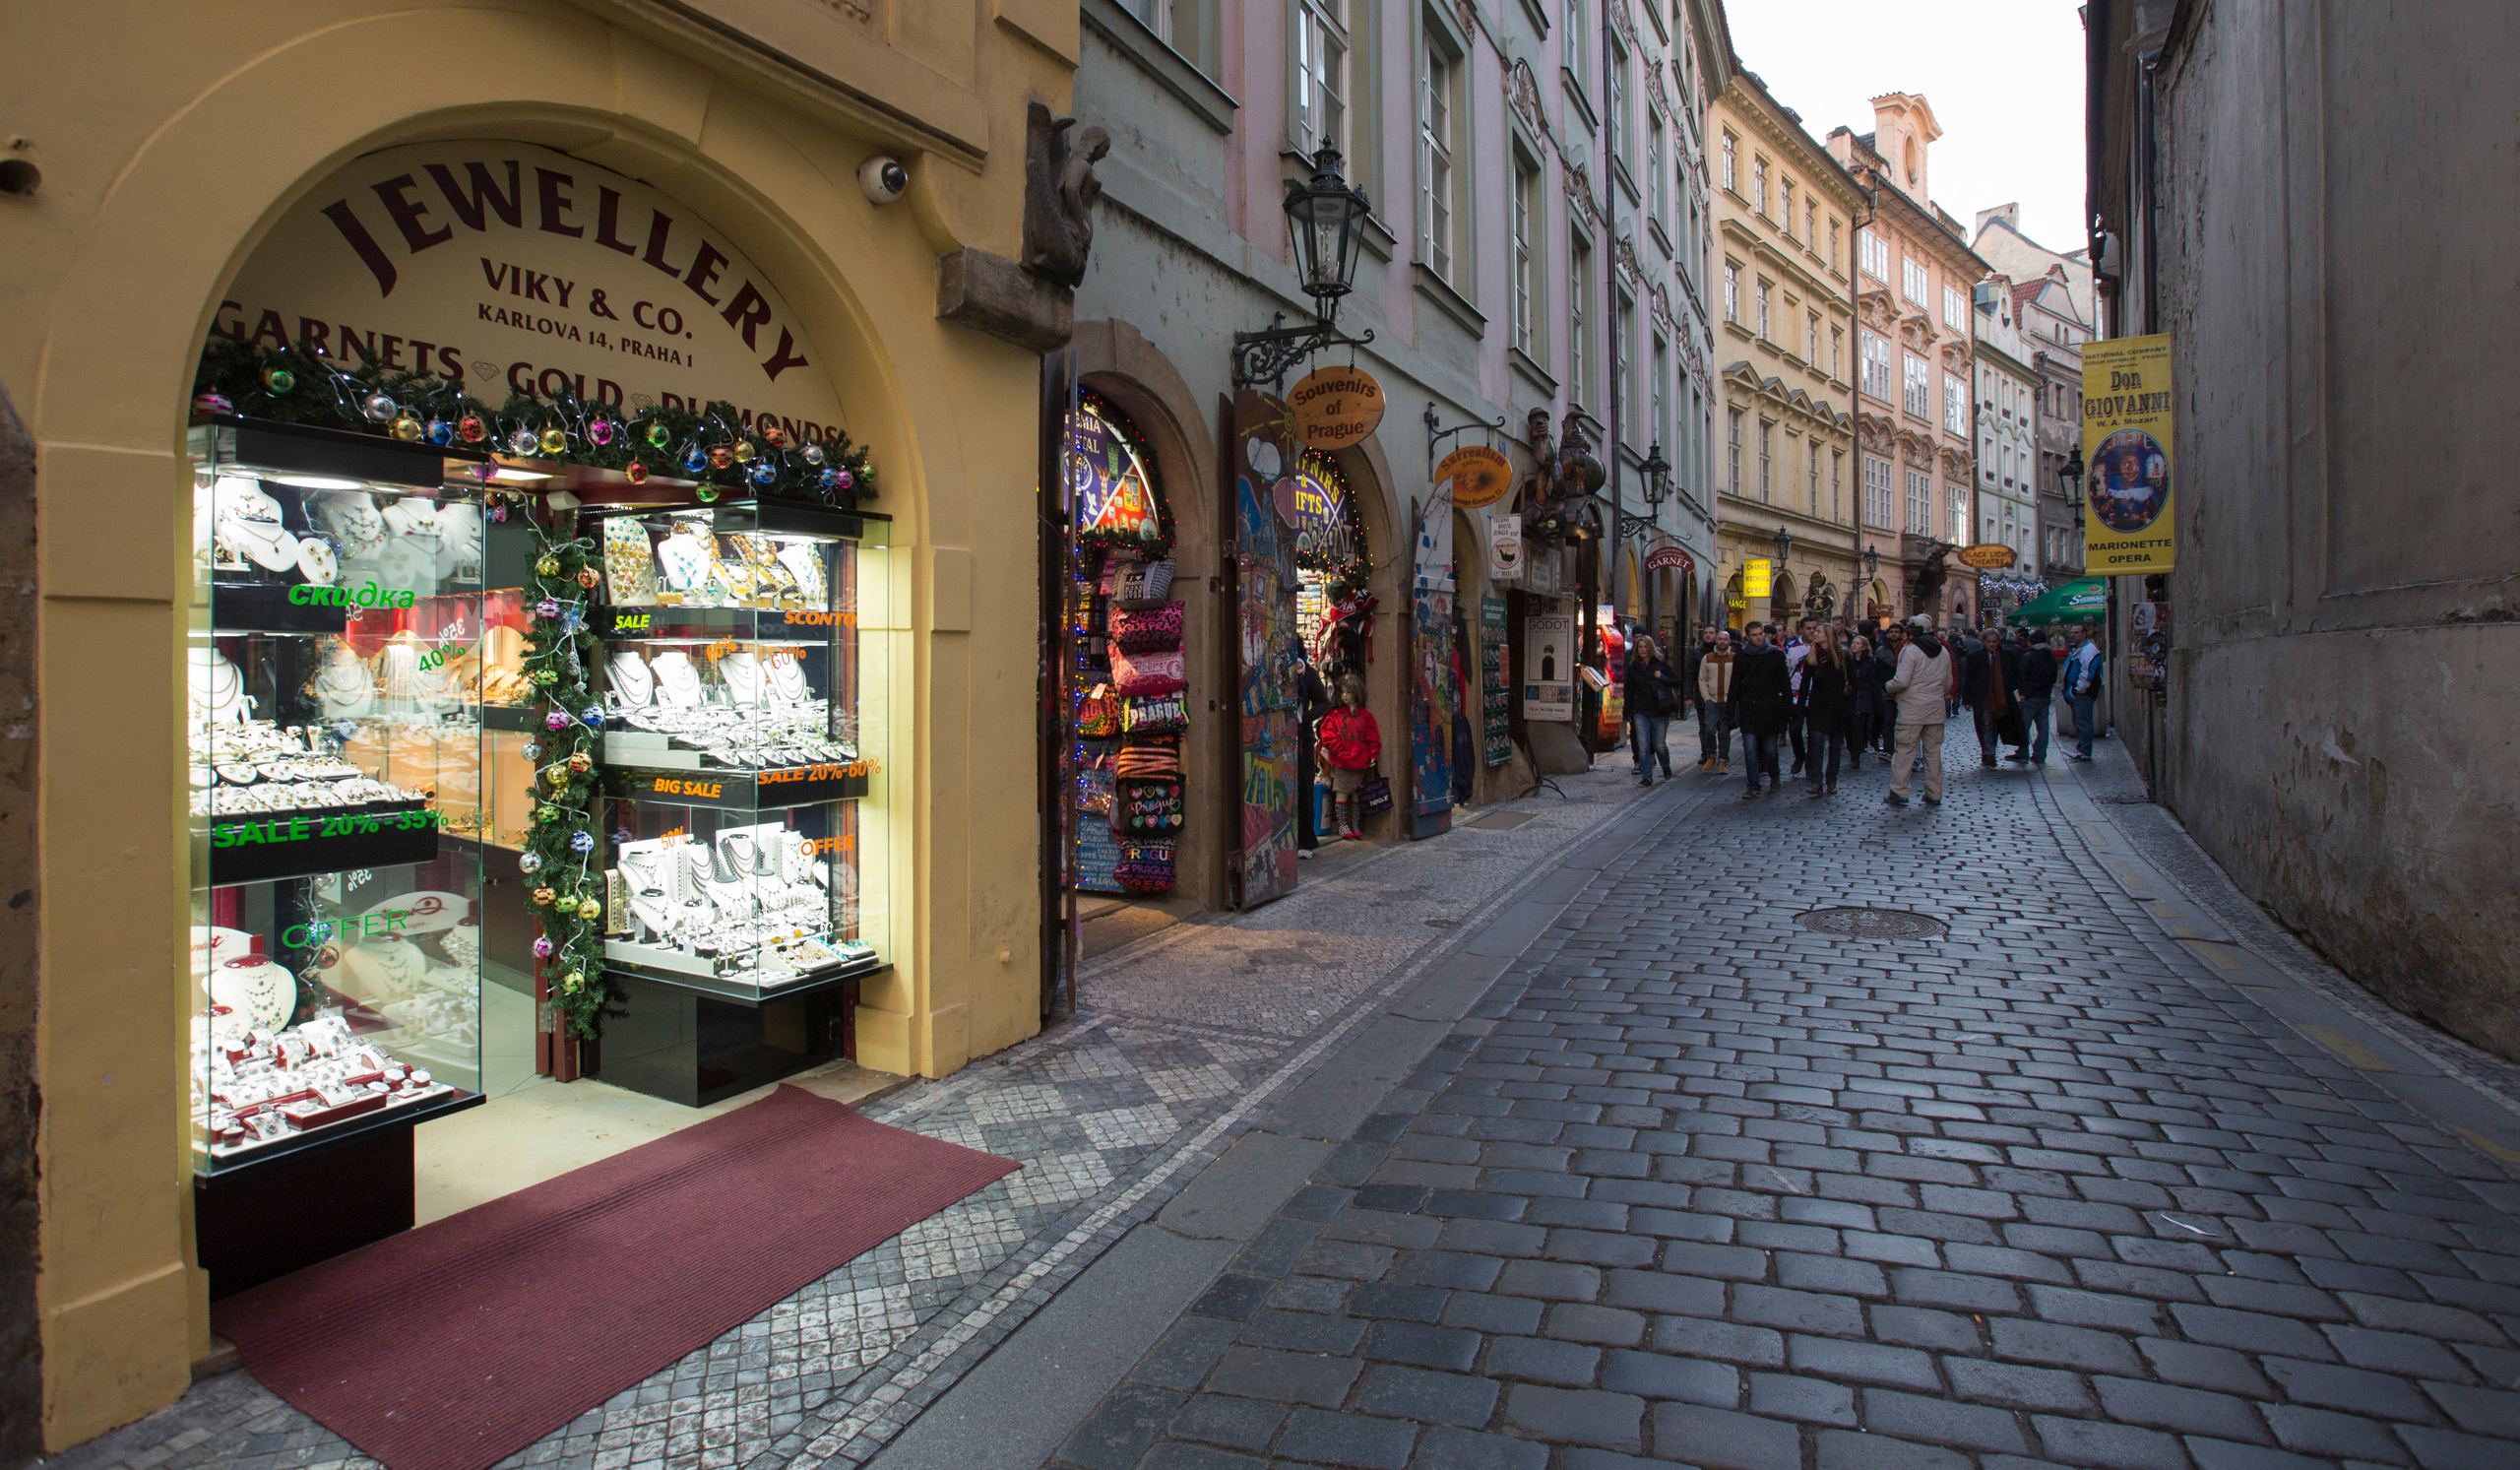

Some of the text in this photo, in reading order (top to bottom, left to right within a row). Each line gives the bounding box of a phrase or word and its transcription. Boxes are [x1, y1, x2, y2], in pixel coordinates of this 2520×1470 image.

[321, 160, 809, 383] JEWELLERY
[479, 256, 693, 340] VIKY & CO.
[210, 299, 465, 382] GARNETS
[477, 302, 693, 368] KARLOVA 14, PRAHA 1
[2085, 346, 2167, 359] NATIONAL COMPANY
[2110, 370, 2142, 391] Don
[1293, 378, 1377, 407] Souvenirs
[1325, 399, 1343, 415] of
[2084, 391, 2172, 419] GIOVANNI
[1306, 420, 1365, 440] Prague
[2123, 415, 2159, 425] Mozart
[1439, 447, 1507, 472] Surrealism
[1462, 459, 1483, 468] gallery
[1300, 474, 1308, 488] &
[2088, 539, 2173, 551] MARIONETTE
[1648, 555, 1691, 570] GARNET
[2109, 553, 2152, 564] OPERA
[288, 581, 415, 609] скидка
[614, 613, 651, 631] SALE
[784, 609, 858, 627] SCONTO
[1530, 619, 1568, 630] GODOT
[418, 640, 467, 673] 40%
[706, 634, 736, 664] 60%
[771, 642, 807, 671] 60%
[1129, 702, 1181, 725] PRAGUE
[1340, 715, 1351, 730] I
[654, 778, 723, 799] BIG SALE
[758, 770, 805, 786] SALE
[1133, 797, 1177, 815] Prague
[214, 816, 311, 849] SALE
[660, 825, 689, 852] 50%
[800, 835, 855, 857] OFFER
[1124, 848, 1175, 863] PRAGUE
[282, 909, 409, 949] OFFER
